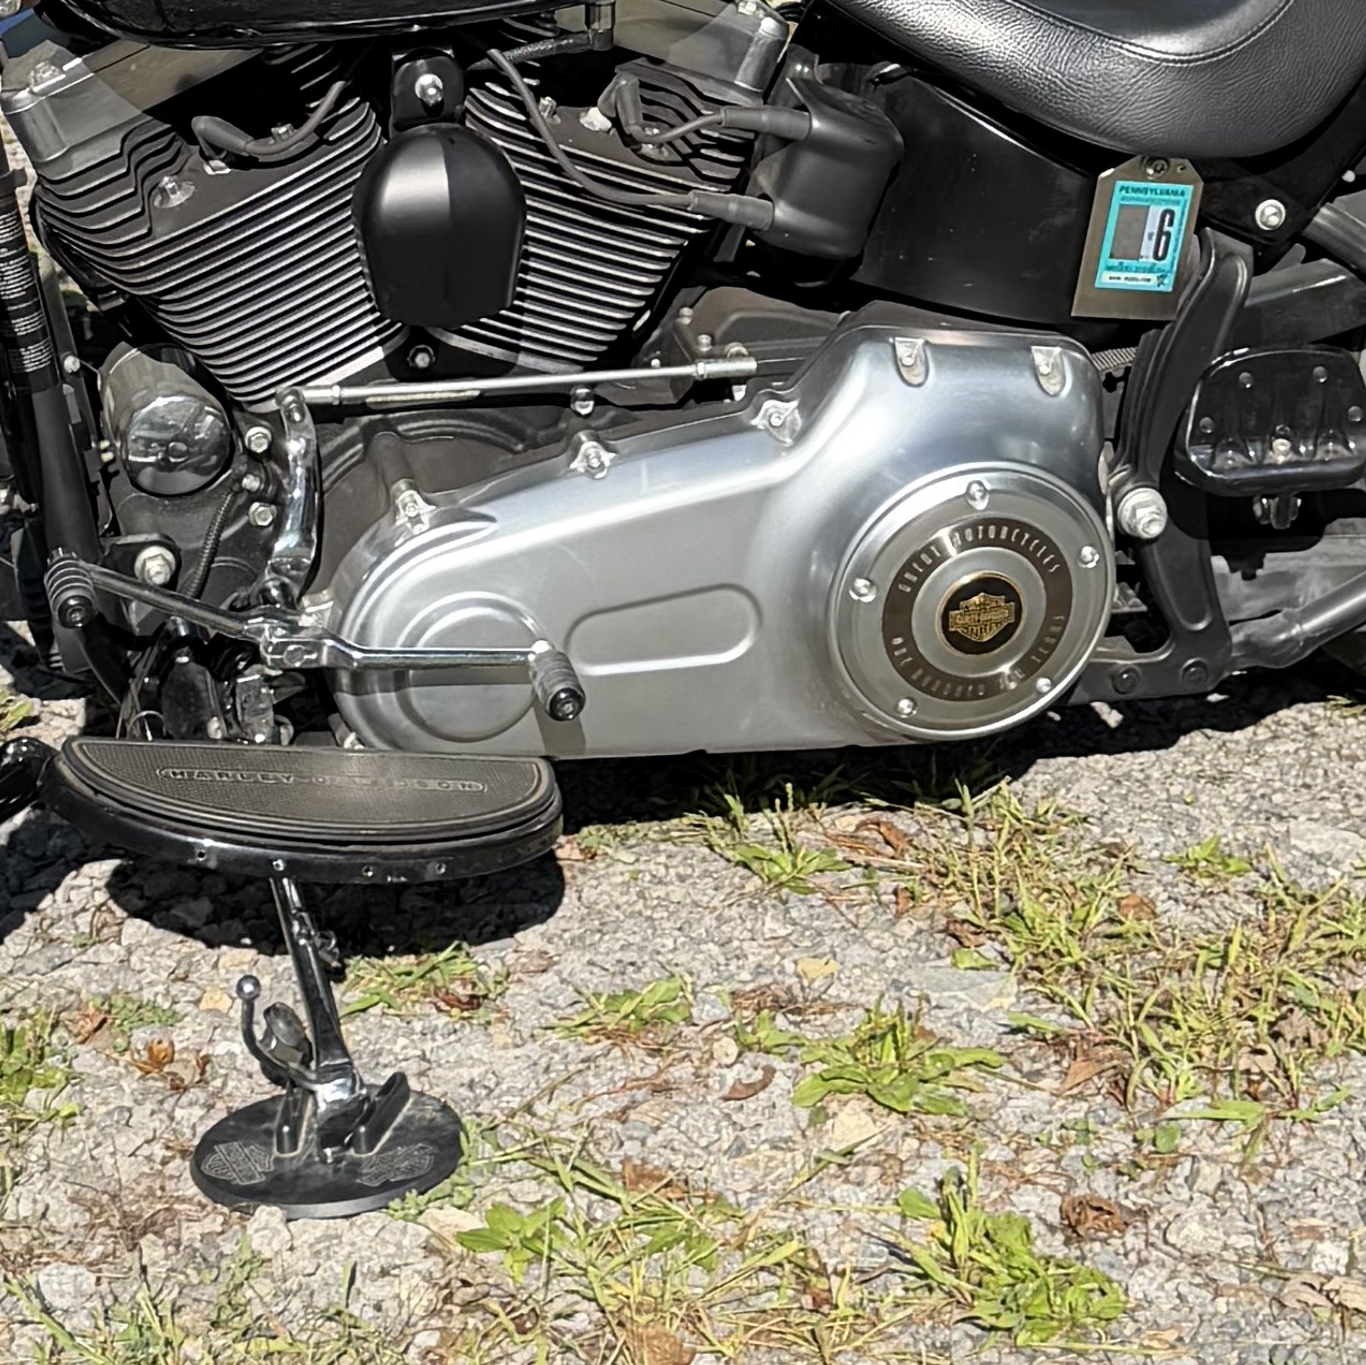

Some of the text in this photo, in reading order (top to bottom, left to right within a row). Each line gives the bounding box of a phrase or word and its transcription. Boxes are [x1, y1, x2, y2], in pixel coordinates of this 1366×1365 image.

[1119, 186, 1185, 196] PENNSYLVANIA
[1153, 208, 1176, 261] 6
[950, 525, 1061, 573] MOTORCYCLES
[170, 768, 482, 792] HARLEY-DVDSON
